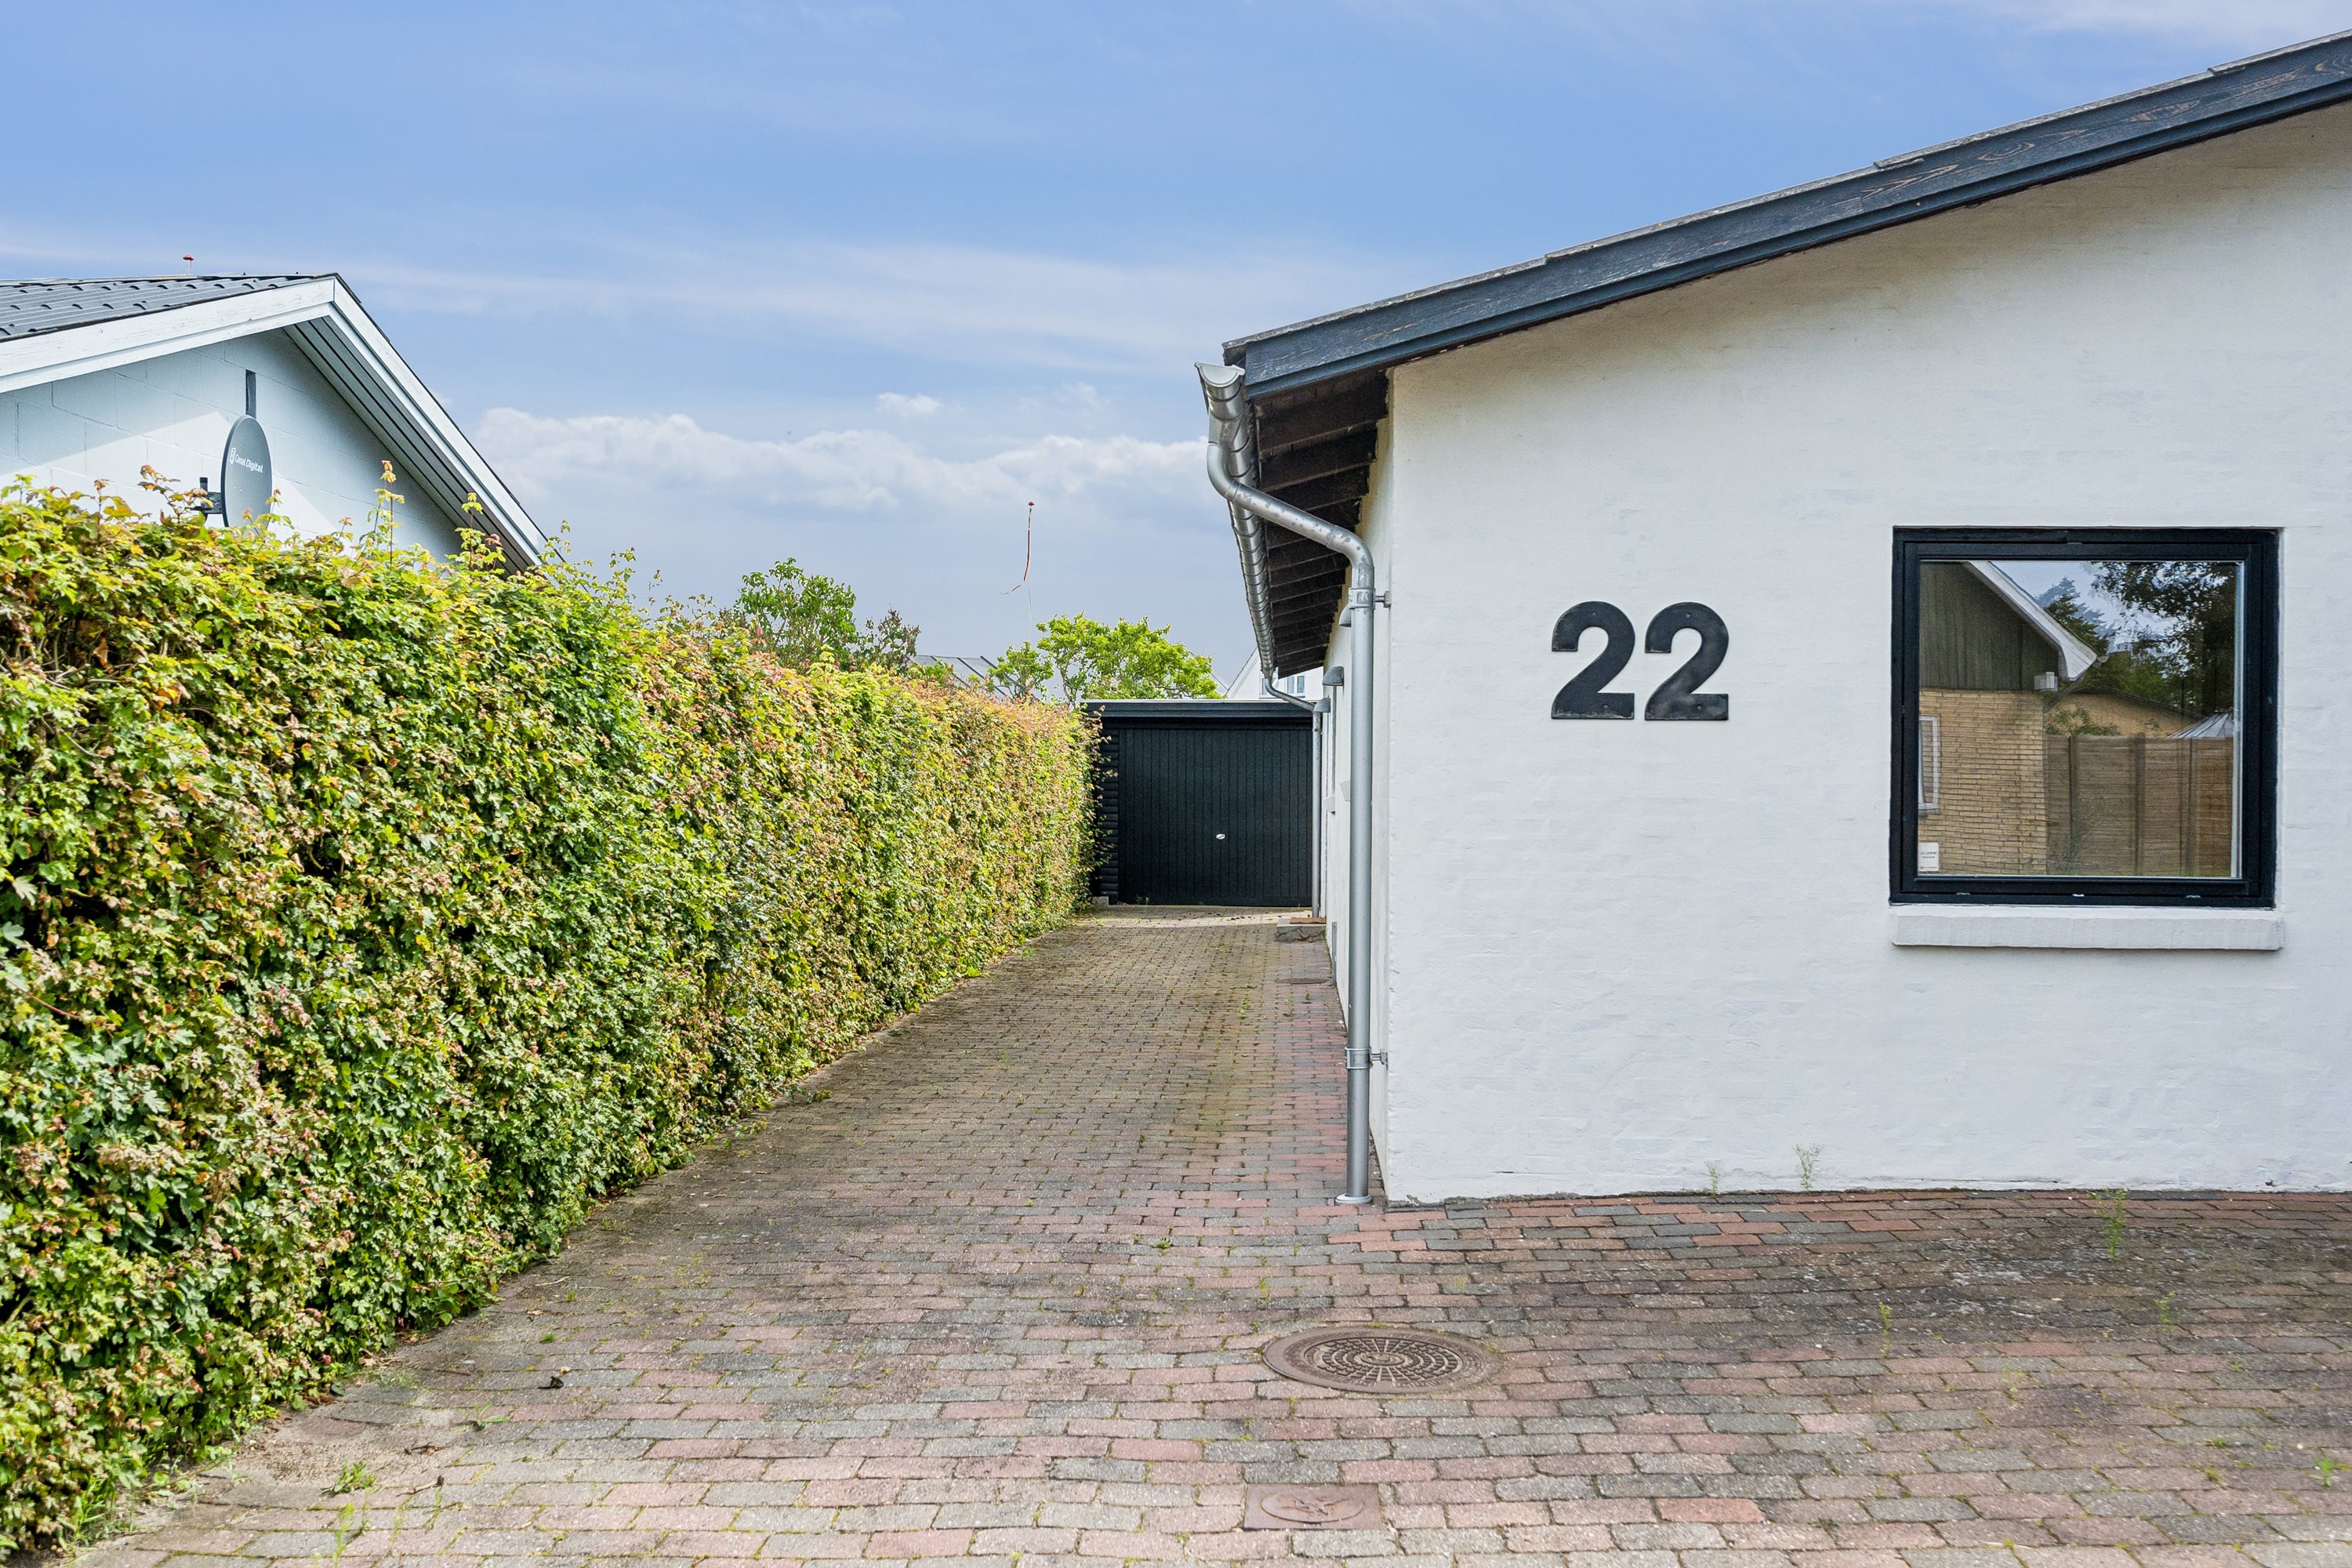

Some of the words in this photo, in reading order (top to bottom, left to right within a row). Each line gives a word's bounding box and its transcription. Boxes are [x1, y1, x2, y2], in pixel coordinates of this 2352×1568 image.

[235, 454, 246, 466] Canal
[245, 459, 263, 473] Digital
[1552, 601, 1730, 720] 22
